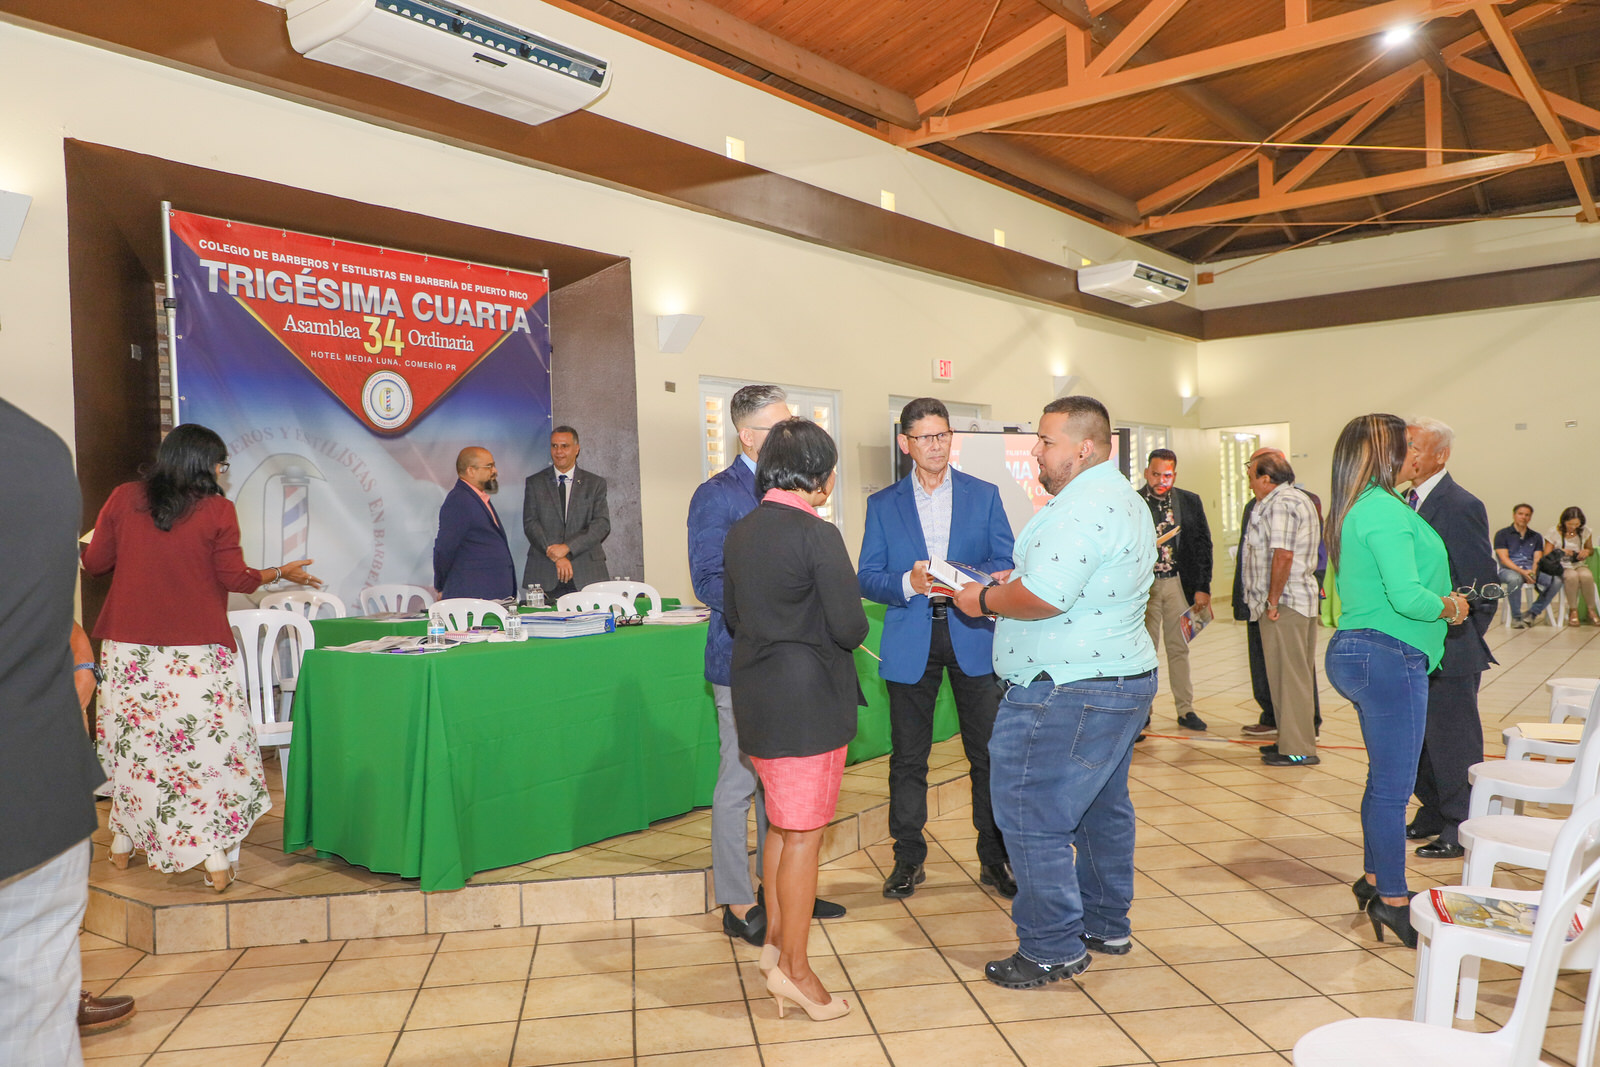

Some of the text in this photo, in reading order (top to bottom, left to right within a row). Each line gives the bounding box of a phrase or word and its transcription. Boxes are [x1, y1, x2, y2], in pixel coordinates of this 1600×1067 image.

[199, 239, 528, 300] COLEGIO DE BARBEROS Y ESTILISTAS EN BARBERÍA DE PUERTO RICO
[199, 258, 531, 334] TRIGÉSIMA CUARTA
[283, 314, 474, 357] Asamblea 34 Ordinaria
[310, 350, 341, 361] HOTEL
[345, 354, 373, 363] MEDIA
[446, 363, 457, 371] PR
[939, 359, 952, 378] EXIT
[228, 427, 274, 459] EROS
[280, 427, 290, 440] Y
[368, 497, 385, 524] EN
